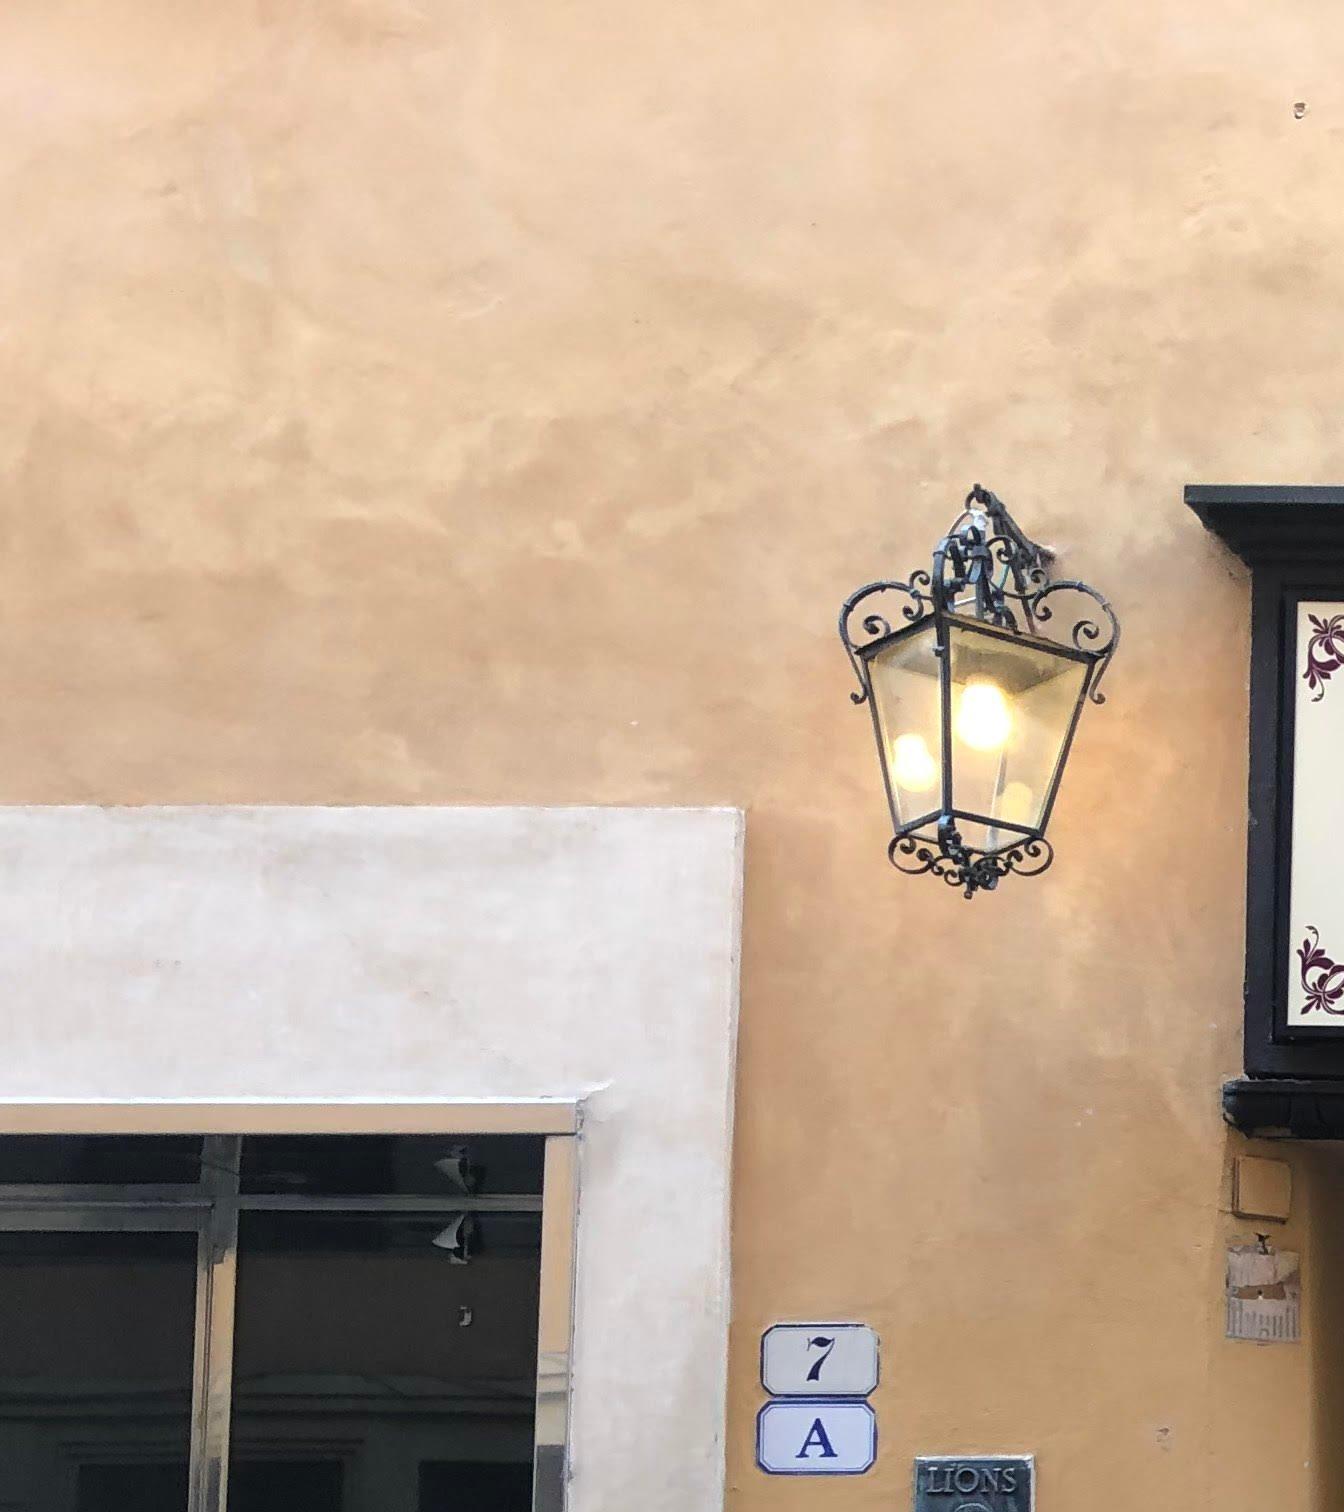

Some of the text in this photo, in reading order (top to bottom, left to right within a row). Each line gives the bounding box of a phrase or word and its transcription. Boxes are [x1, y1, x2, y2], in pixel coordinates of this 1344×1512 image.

[806, 1336, 836, 1382] 7
[795, 1417, 838, 1459] A
[925, 1465, 1018, 1494] LIONS
